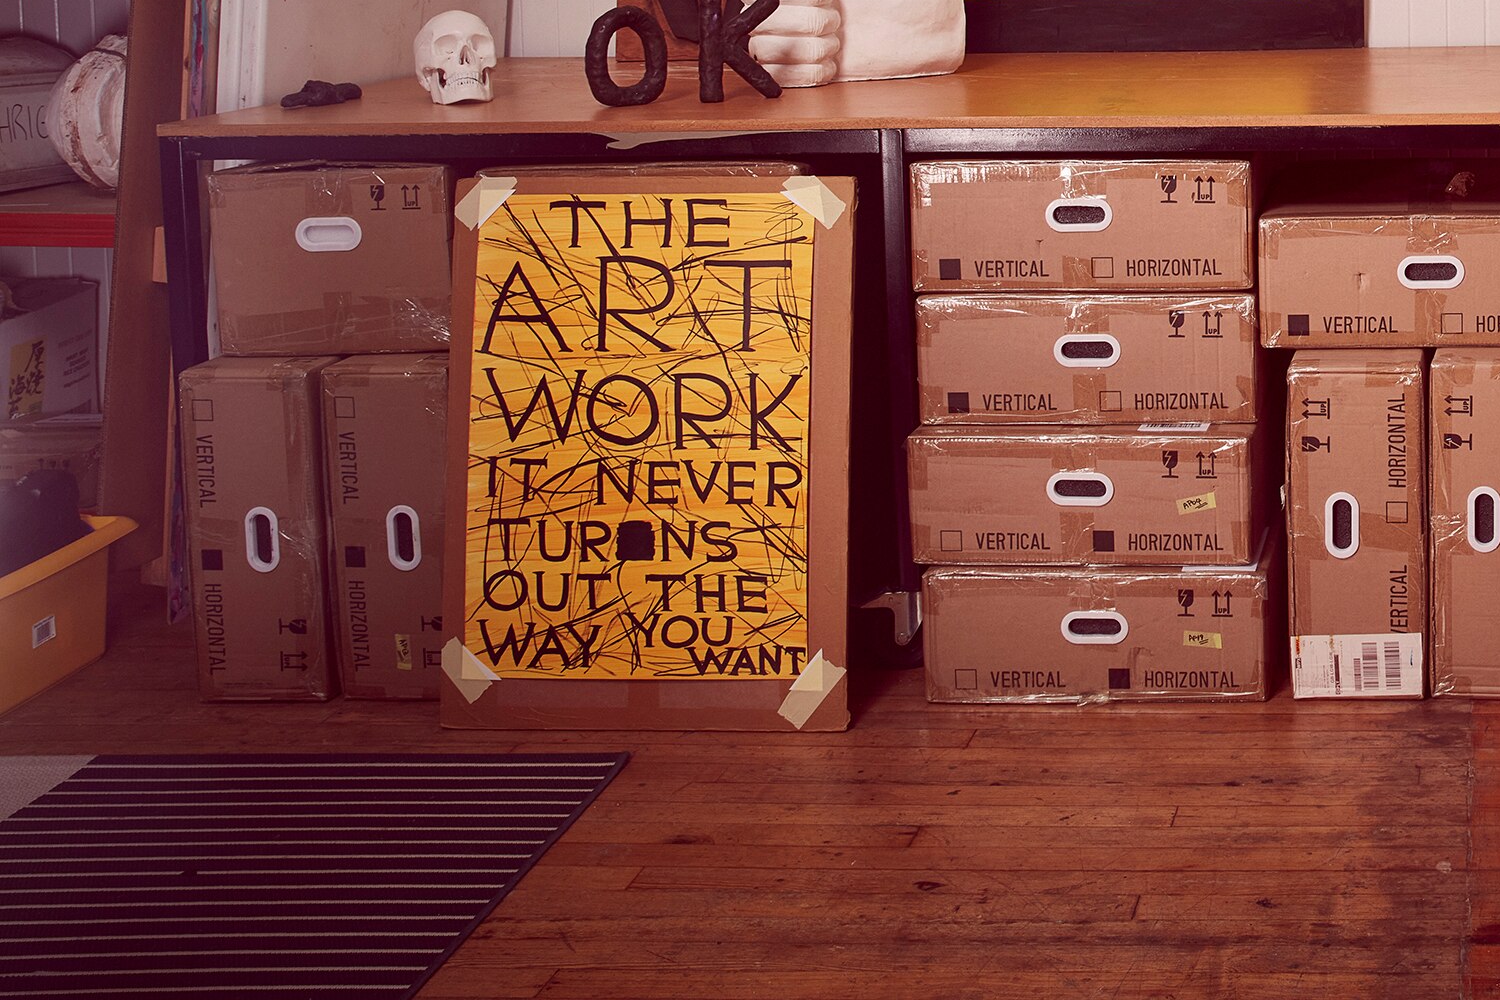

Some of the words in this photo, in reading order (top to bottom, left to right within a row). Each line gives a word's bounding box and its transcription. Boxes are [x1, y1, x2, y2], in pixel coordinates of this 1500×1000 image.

[549, 198, 731, 249] THE
[974, 260, 1049, 278] VERTICAL
[1126, 258, 1222, 277] HORIZONTAL
[476, 256, 793, 354] ART
[1323, 316, 1398, 334] VERTICAL
[482, 366, 806, 452] WORK
[982, 393, 1057, 411] VERTICAL
[1134, 392, 1229, 410] HORIZONTAL
[1387, 393, 1407, 488] HORIZONTAL
[195, 435, 216, 508] VERTICAL
[339, 431, 359, 504] VERTICAL
[487, 456, 548, 499] IT
[594, 457, 803, 509] NEVER
[975, 533, 1051, 550] VERTICAL
[1128, 533, 1223, 551] HORIZONTAL
[483, 569, 612, 613] OUT
[645, 573, 769, 614] THE
[204, 584, 226, 675] HORIZONTAL
[348, 580, 371, 672] HORIZONTAL
[478, 618, 603, 671] WAY
[627, 611, 734, 650] YOU
[688, 646, 806, 677] WANT
[990, 671, 1066, 688] VERTICAL
[1145, 670, 1239, 688] HORIZONTAL
